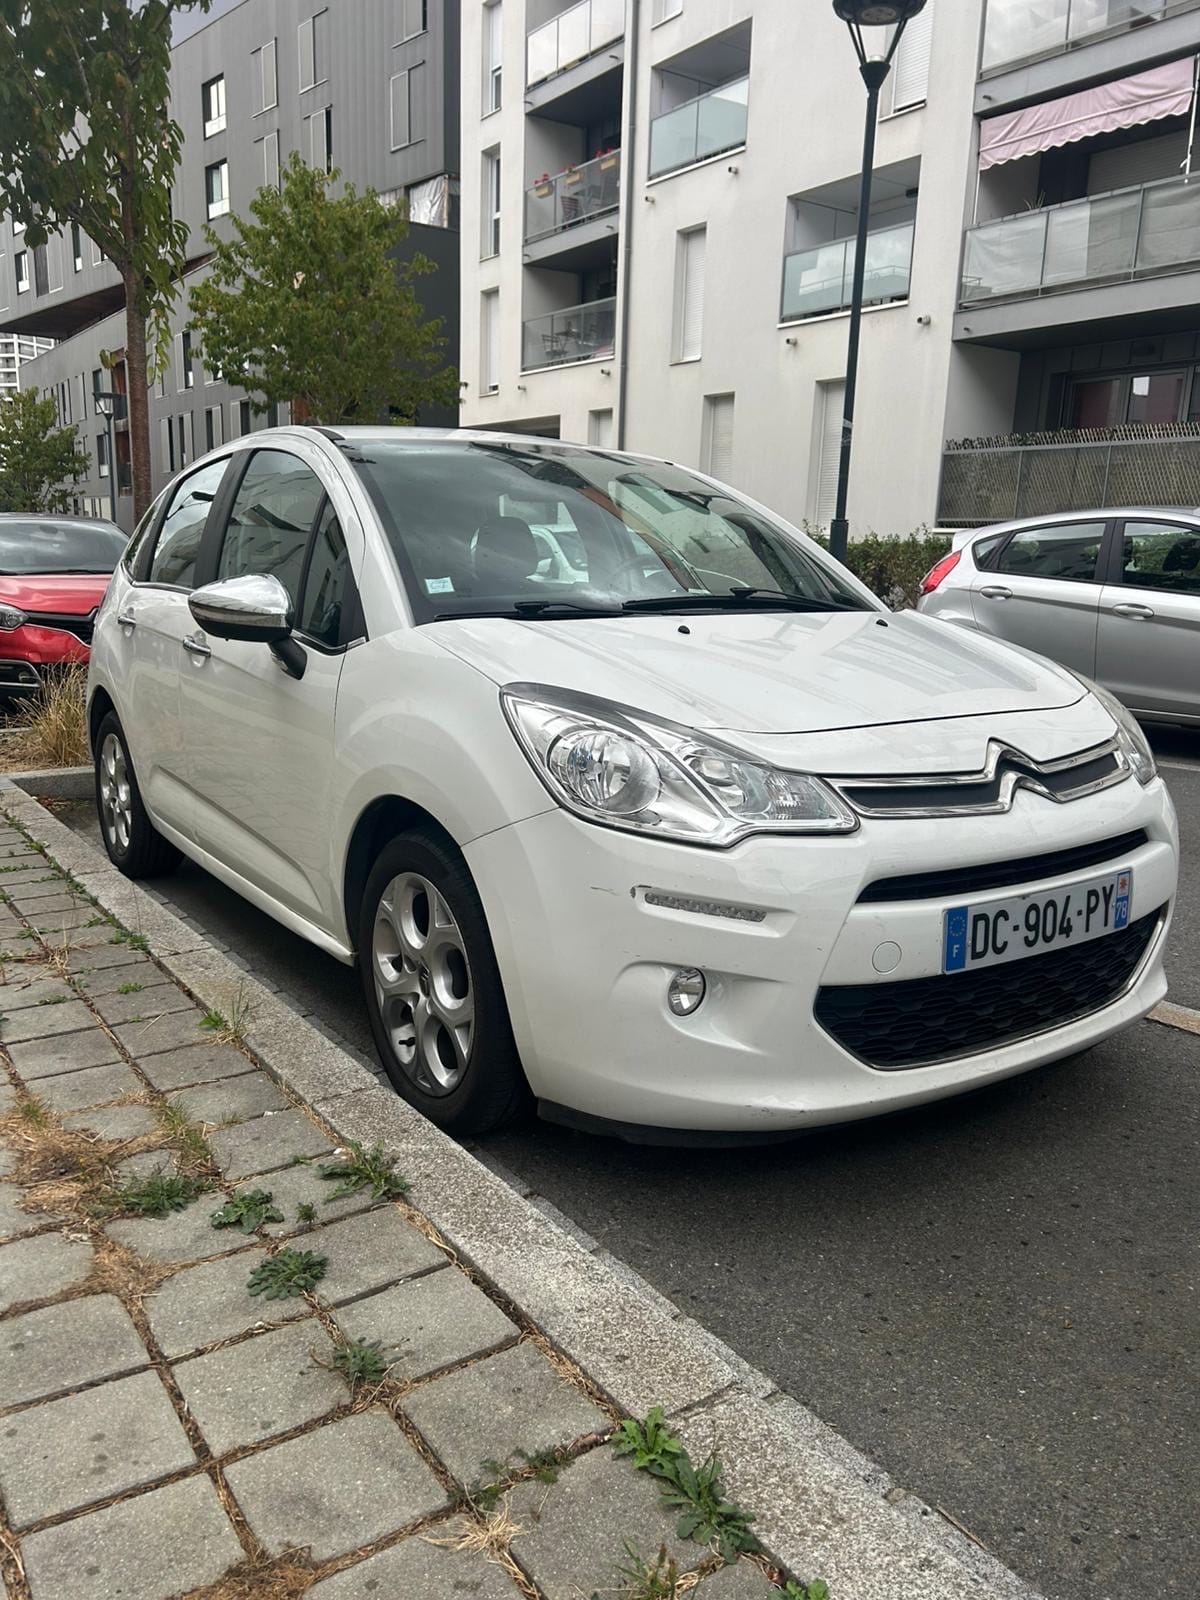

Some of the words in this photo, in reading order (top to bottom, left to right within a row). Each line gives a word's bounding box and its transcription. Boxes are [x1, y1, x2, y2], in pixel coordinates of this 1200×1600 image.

[1116, 900, 1128, 921] 78
[970, 884, 1114, 960] DC-904-PY
[952, 944, 960, 958] F
